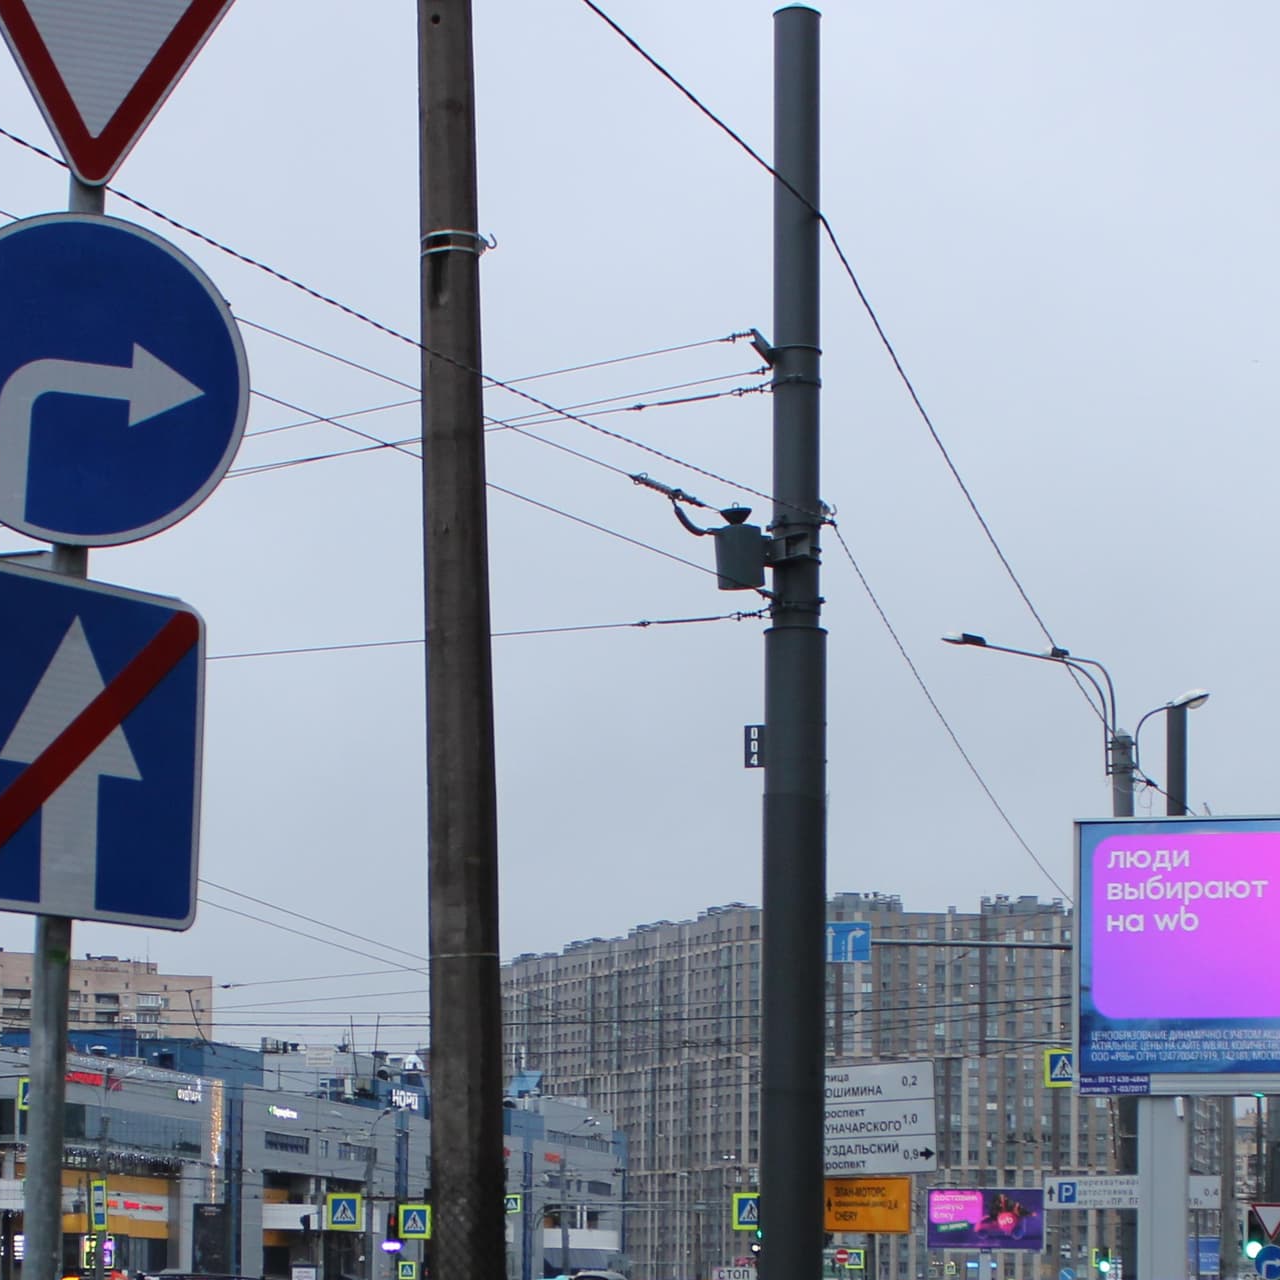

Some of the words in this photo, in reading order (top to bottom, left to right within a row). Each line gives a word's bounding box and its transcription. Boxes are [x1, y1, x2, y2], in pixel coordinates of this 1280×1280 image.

[750, 727, 758, 766] 004
[1107, 849, 1191, 872] люди
[1106, 875, 1269, 904] выбирают
[1106, 912, 1146, 933] на
[1154, 905, 1200, 933] wb
[825, 1073, 849, 1083] лица
[901, 1075, 918, 1088] 0,2
[392, 1089, 418, 1110] НОРД
[825, 1085, 883, 1099] ОШИМИНА
[825, 1107, 865, 1119] роспект
[903, 1114, 918, 1126] 1,0
[825, 1120, 902, 1135] УНАЧАРСКОГО
[825, 1142, 900, 1157] УЗДАЛЬСКИЙ
[903, 1149, 919, 1160] 0,9
[825, 1160, 866, 1171] роспект
[718, 1268, 750, 1280] СТОП
